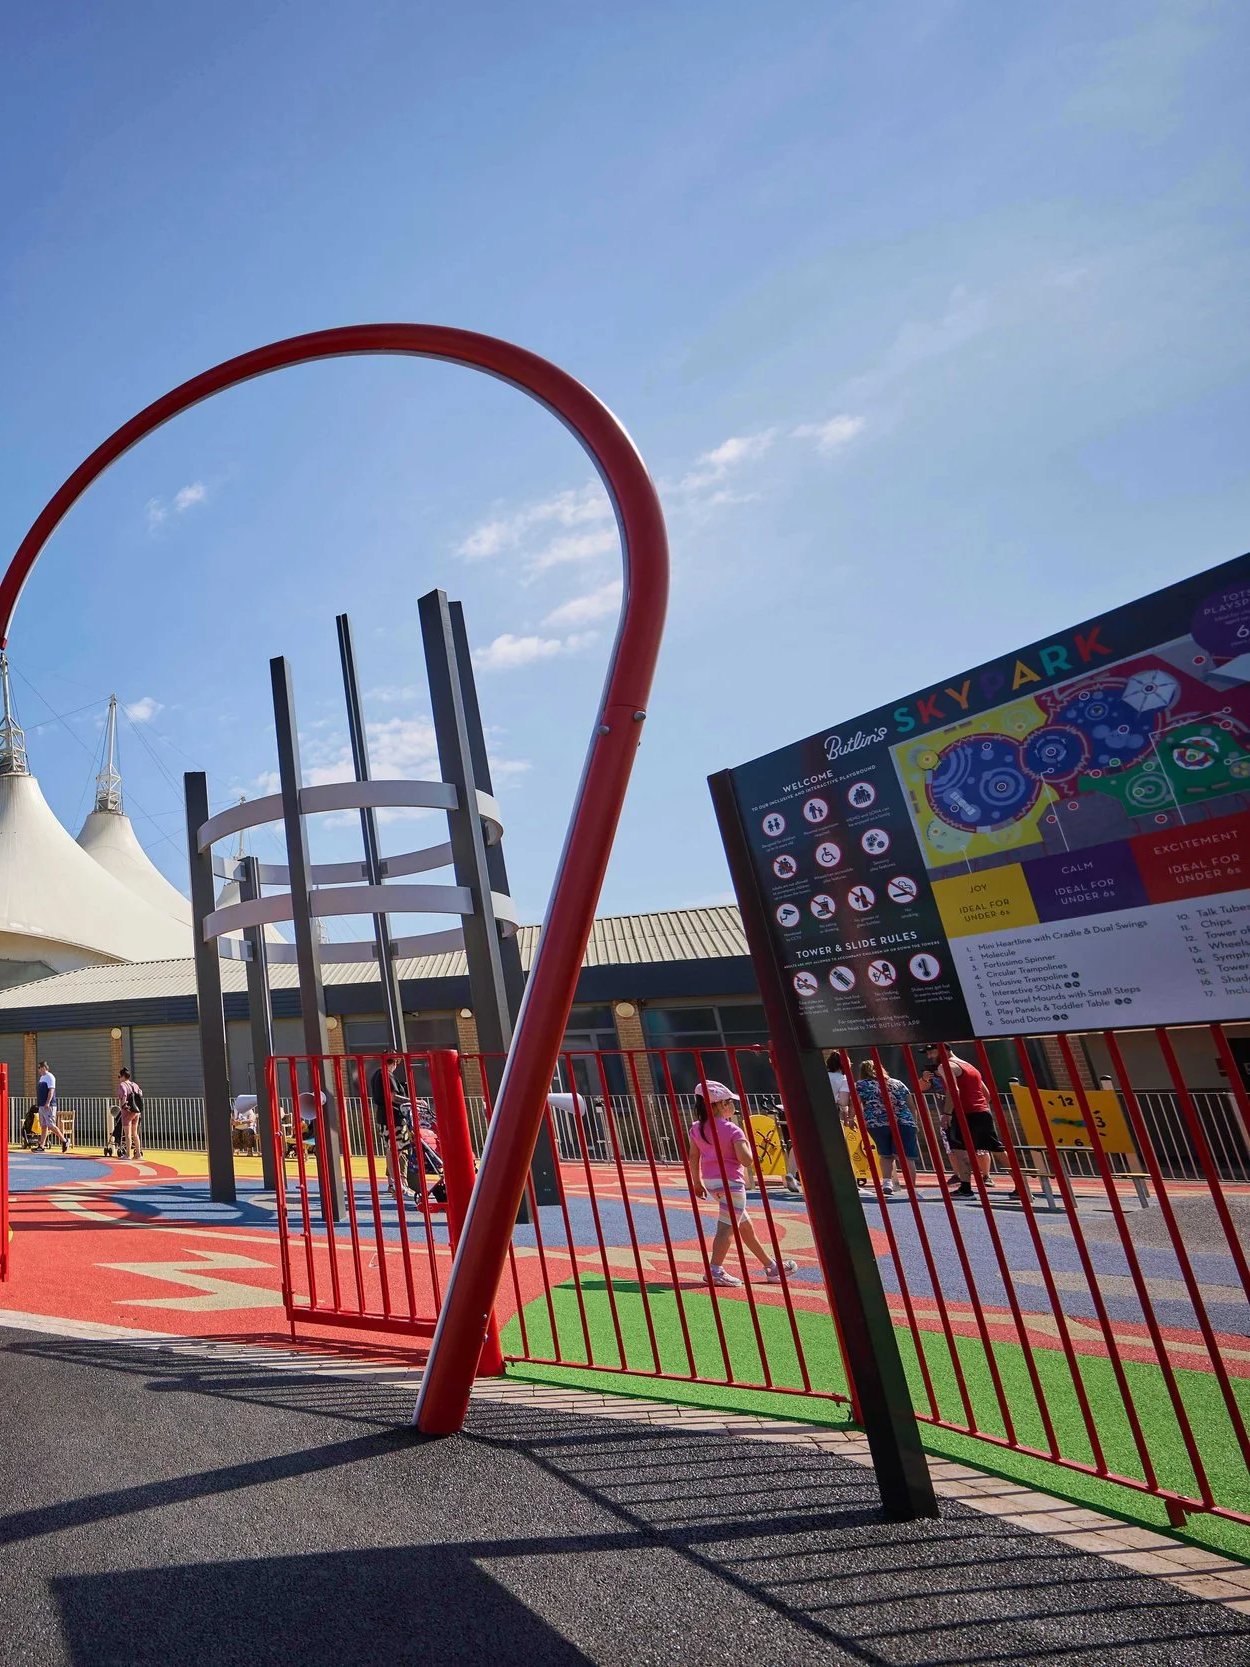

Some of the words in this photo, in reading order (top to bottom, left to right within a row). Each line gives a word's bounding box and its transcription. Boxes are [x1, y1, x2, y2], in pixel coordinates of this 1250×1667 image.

[1237, 624, 1250, 638] 6
[824, 727, 888, 760] Butlin's
[769, 794, 794, 806] INCLUSIVE
[805, 778, 839, 793] INTERACTIVE
[839, 764, 876, 781] PLAYGROUND
[782, 769, 834, 793] WELCOME
[1153, 830, 1238, 855] EXCITEMENT
[1061, 861, 1094, 874] CALM
[1168, 860, 1207, 875] IDEAL
[1211, 853, 1240, 866] FOR
[1175, 869, 1222, 884] UNDER
[970, 883, 987, 893] JOY
[1054, 884, 1088, 896] IDEAL
[1090, 878, 1114, 889] FOR
[1060, 891, 1099, 905] UNDER
[959, 903, 987, 914] IDEAL
[989, 898, 1010, 908] FOR
[1195, 907, 1219, 918] Talk
[1219, 904, 1250, 914] Tubes
[964, 910, 996, 922] UNDER
[1200, 919, 1232, 929] Chips
[978, 943, 995, 951] Mini
[996, 937, 1032, 948] Heartline
[1033, 932, 1051, 942] with
[1052, 929, 1082, 940] Cradle
[1083, 927, 1091, 935] &
[1092, 923, 1114, 934] Dual
[1115, 920, 1148, 931] Swings
[1203, 929, 1238, 939] Tower
[795, 946, 832, 959] TOWER
[835, 944, 842, 952] &
[845, 938, 877, 951] SLIDE
[880, 931, 917, 945] RULES
[1208, 938, 1250, 951] Wheels
[980, 949, 1016, 960] Molecule
[983, 956, 1024, 969] Fortissimo
[1024, 954, 1056, 965] Spinner
[1212, 950, 1250, 962] Symph
[986, 969, 1016, 979] Circular
[1018, 963, 1068, 974] Trampolines
[1216, 964, 1249, 973] Tower
[989, 977, 1022, 987] Inclusive
[1024, 973, 1069, 983] Trampoline
[1220, 973, 1250, 984] Shad
[991, 986, 1033, 997] Interactive
[1034, 983, 1062, 992] SONA
[994, 996, 1032, 1006] Low-level
[1032, 992, 1066, 1002] Mounds
[1067, 990, 1086, 999] with
[1087, 987, 1112, 997] Small
[1113, 986, 1141, 995] Steps
[997, 1008, 1014, 1016] Play
[1015, 1005, 1041, 1014] Panels
[1051, 1001, 1084, 1011] Toddler
[1086, 999, 1110, 1008] Table
[999, 1016, 1025, 1025] Sound
[1058, 1094, 1074, 1107] 12
[1095, 1117, 1106, 1128] 3
[1074, 1138, 1084, 1147] 6
